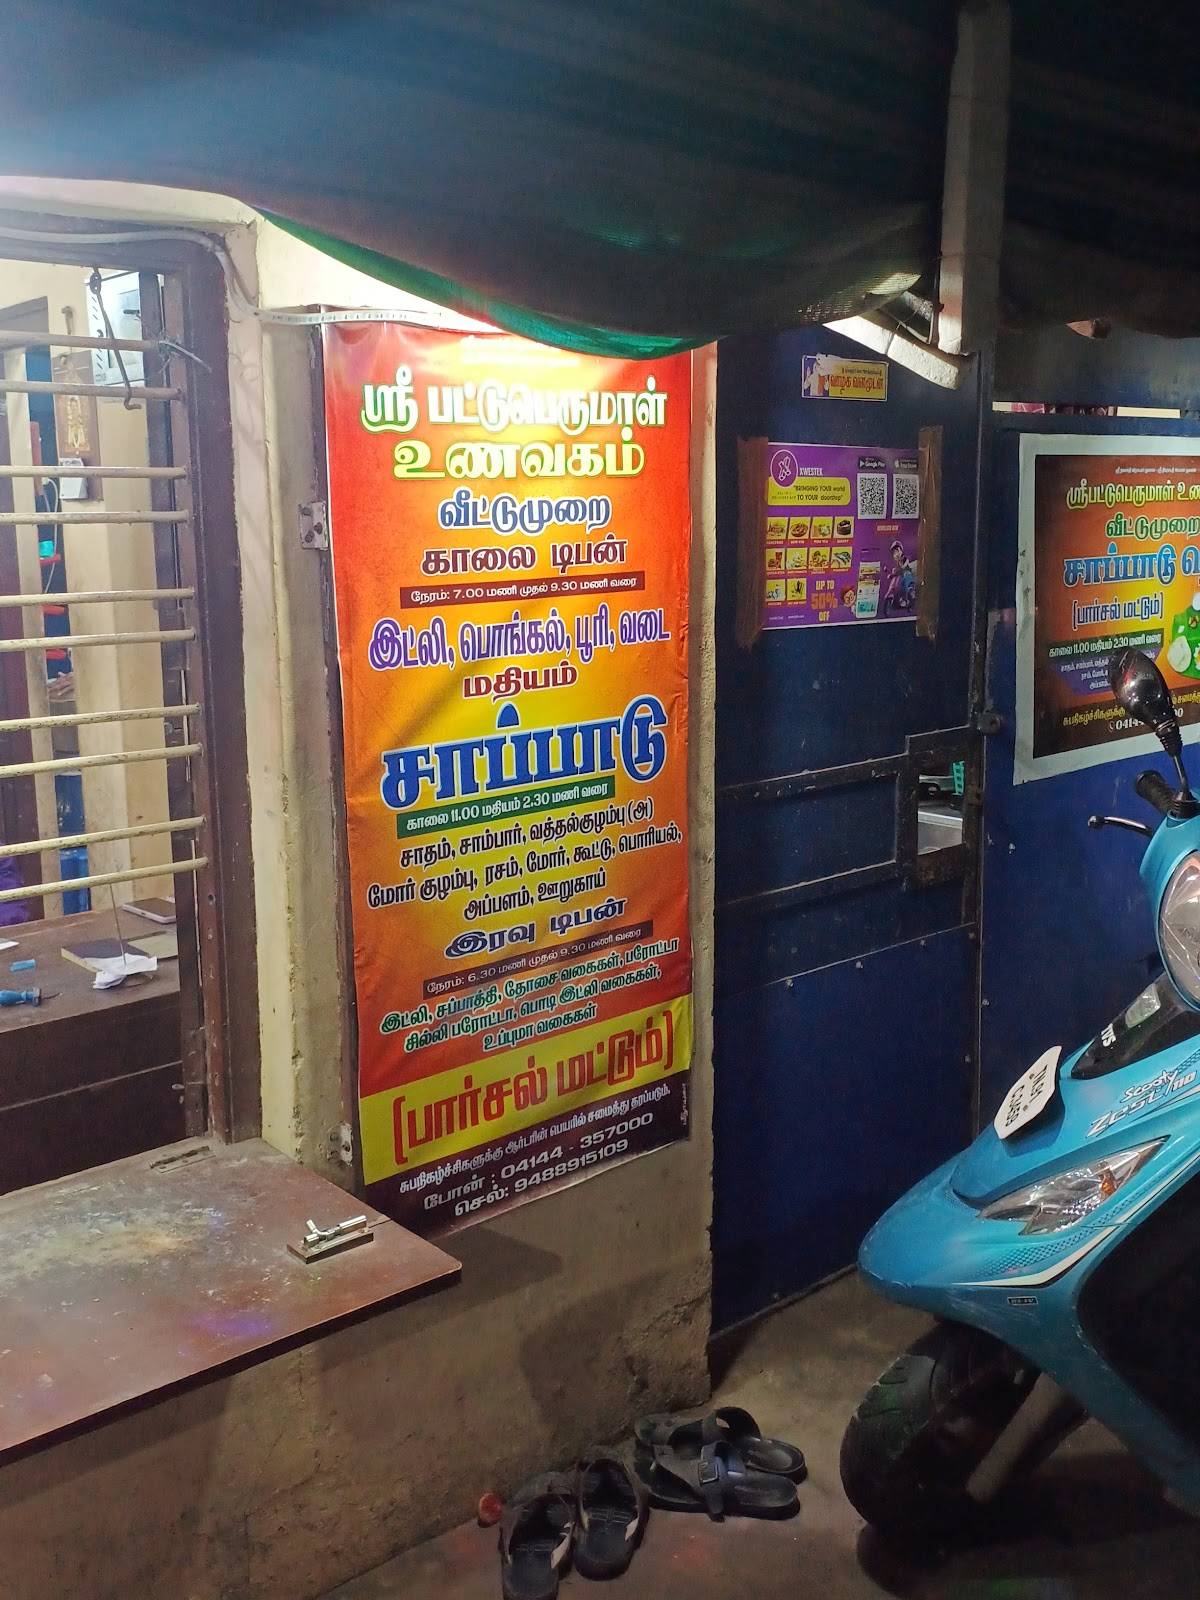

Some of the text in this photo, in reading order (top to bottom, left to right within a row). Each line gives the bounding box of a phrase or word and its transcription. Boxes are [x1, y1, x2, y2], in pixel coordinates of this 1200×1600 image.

[427, 376, 668, 435] பட்டுபெருமாள்
[393, 426, 645, 479] உணவகம்
[437, 487, 612, 534] வீட்டுமுறை
[421, 533, 628, 576] காலை டிபன்
[1064, 541, 1177, 587] சாப்பாடு
[410, 577, 637, 604] நேரம்: 7.00 மணி முதல் 9.30 மணி வரை
[816, 581, 825, 590] UP
[369, 601, 670, 669] இட்லி, பொங்கல், பூரி, வடை
[818, 611, 829, 621] OFF
[1049, 647, 1072, 658] காலை
[1073, 642, 1089, 653] 11.00
[1090, 639, 1113, 653] மதியம்
[463, 660, 578, 702] மதியம்
[380, 694, 667, 810] சாப்பாடு
[400, 797, 654, 869] சாதம், சாம்பார், வத்தல்குழம்பு (அ)
[406, 783, 608, 831] காலை 11.00 மதியம் 2.30 மணி வரை
[367, 821, 682, 909] மோர் குழம்பு, ரசம், மோர், கூட்டு, பொரியல்,
[463, 868, 607, 921] அப்பளம், ஊறுகாய்
[445, 897, 628, 959] இரவு டிபன்
[380, 937, 679, 1034] இட்லி, சப்பாத்தி, தோசை வகைகள், பரோட்டா
[427, 928, 642, 996] நேரம்: 6.30 மணி முதல் 9.30 மணி வரை
[404, 965, 662, 1053] சில்லி பரோட்டா, பொடி இட்லி வகைகள்,
[483, 1003, 598, 1051] உப்புமா வகைகள்
[1100, 1023, 1116, 1047] TVS
[1120, 1069, 1178, 1103] Scooty
[1086, 1090, 1164, 1138] Zest
[400, 1147, 504, 1194] சுபநிகழ்ச்சிகளுக்கு
[505, 1128, 549, 1155] ஆர்டரின்
[549, 1112, 587, 1137] பெயரில்
[587, 1099, 631, 1123] சமைத்து
[424, 1175, 485, 1210] போன்
[501, 1146, 563, 1180] 04144
[580, 1112, 654, 1149] 357000
[455, 1139, 629, 1216] செல்: 9488915109
